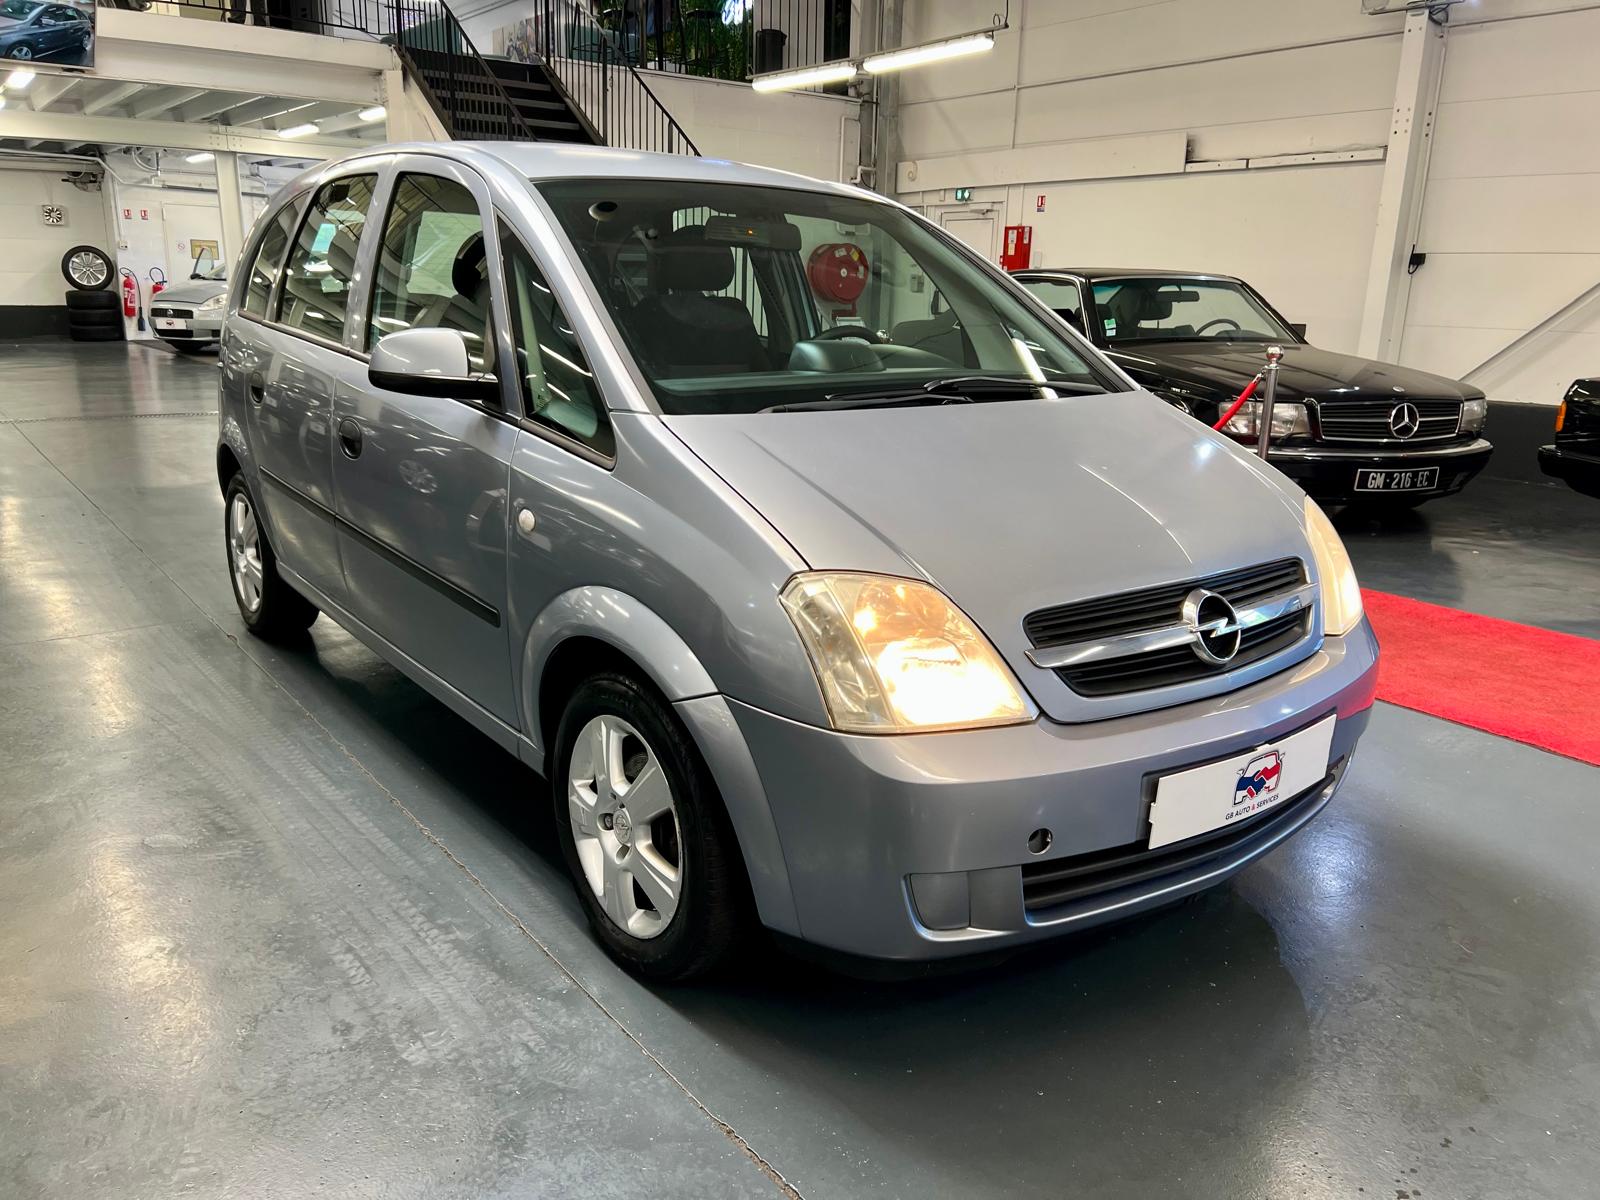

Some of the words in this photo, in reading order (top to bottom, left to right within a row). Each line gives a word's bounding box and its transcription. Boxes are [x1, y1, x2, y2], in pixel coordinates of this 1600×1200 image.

[1225, 811, 1234, 820] GB
[1235, 805, 1251, 817] AUTO
[1256, 793, 1279, 809] SERVICES
